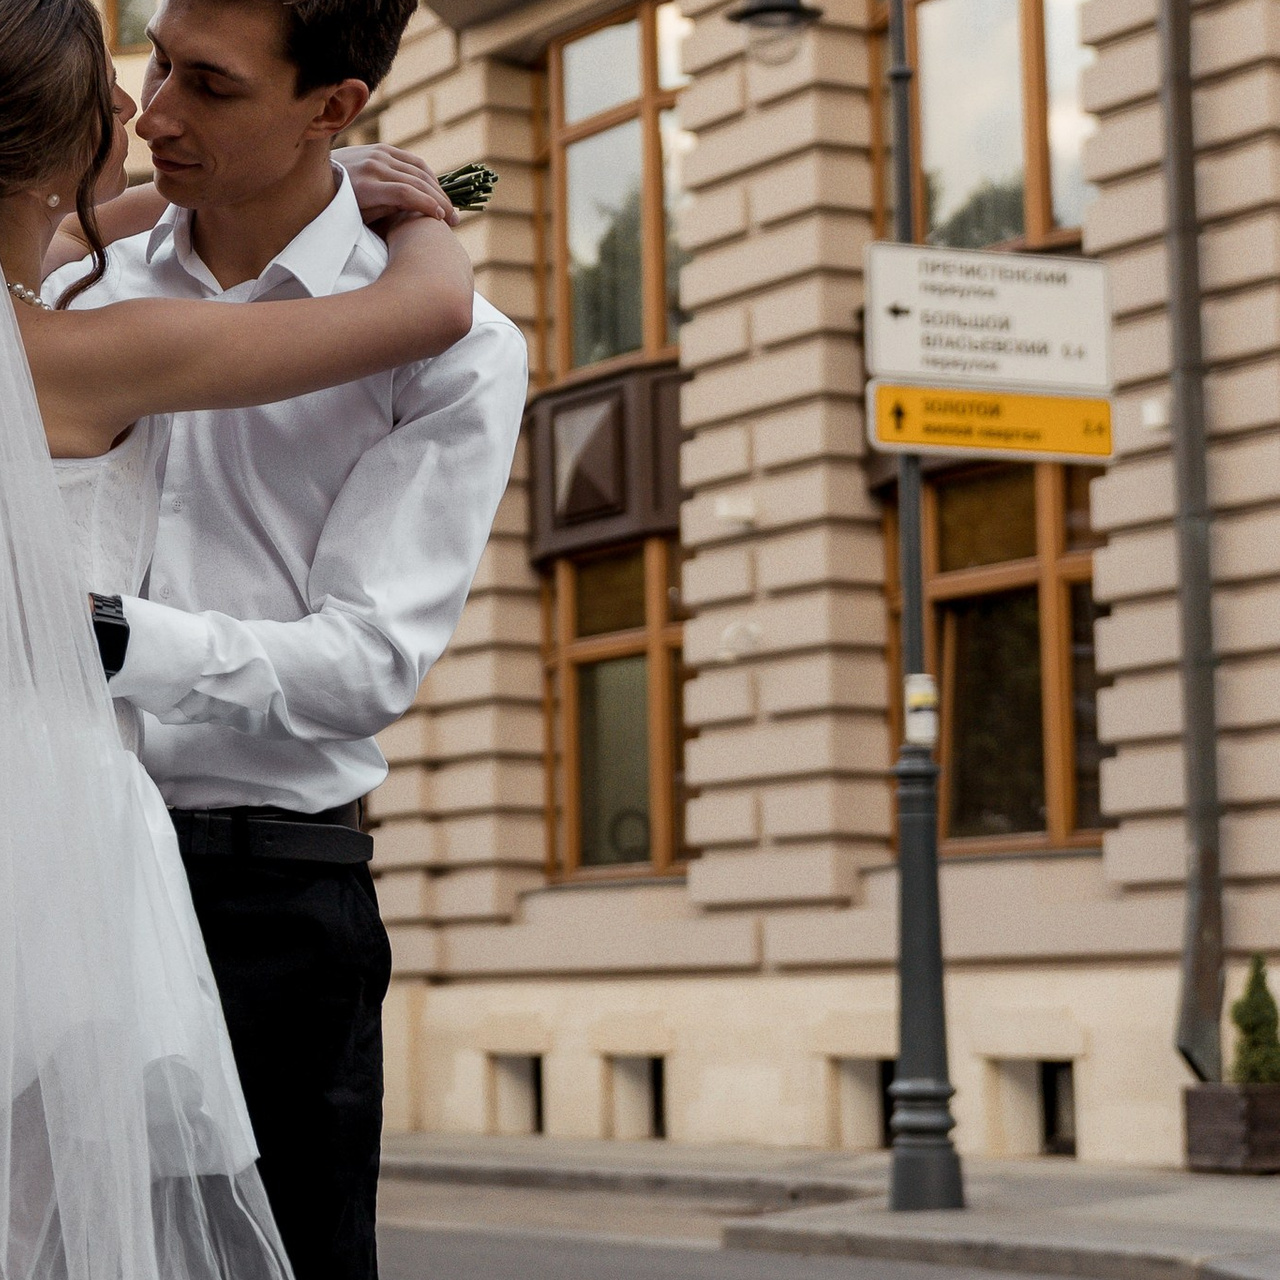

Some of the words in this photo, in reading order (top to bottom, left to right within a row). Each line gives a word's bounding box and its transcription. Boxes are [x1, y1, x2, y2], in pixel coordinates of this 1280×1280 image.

[921, 308, 1010, 331] БОЛЬШОЙ
[921, 333, 1050, 356] ВЛАСЬЕВСКИЙ
[923, 397, 1002, 418] ЗОЛОТОЙ
